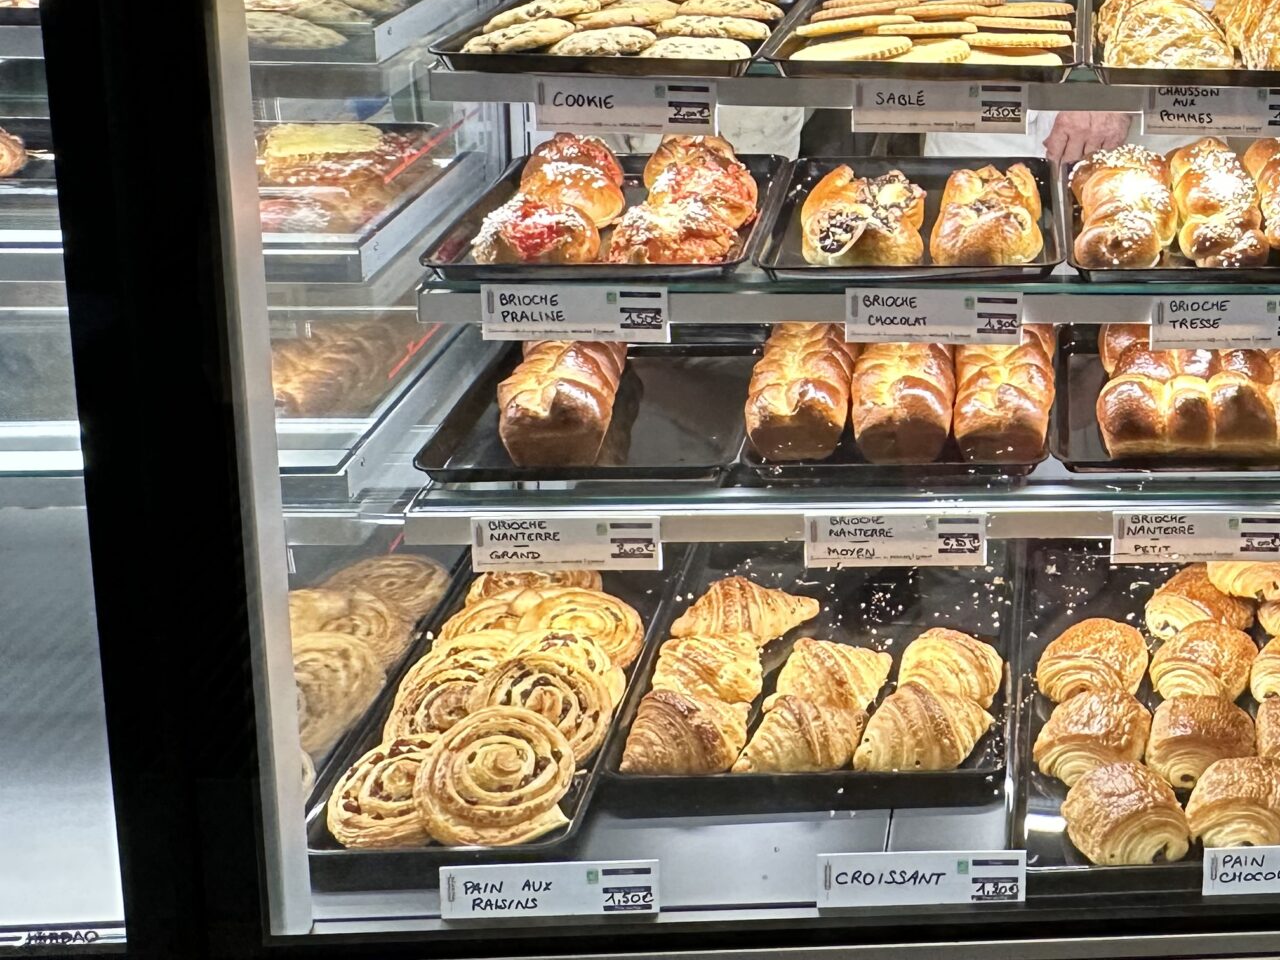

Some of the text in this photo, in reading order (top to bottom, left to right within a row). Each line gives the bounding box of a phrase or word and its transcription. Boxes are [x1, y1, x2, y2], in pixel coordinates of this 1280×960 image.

[1158, 87, 1220, 97] CHAUSSON
[552, 91, 615, 109] COOKIE
[875, 91, 926, 107] SABLÉ
[1173, 98, 1196, 107] AUX
[1160, 109, 1214, 124] POMMES
[499, 293, 559, 307] BRIOCHE
[862, 294, 918, 309] BRIOCHE
[1169, 300, 1231, 313] BRIOCHE
[501, 310, 566, 323] PRALINE
[867, 314, 928, 326] CHOCOLAT
[1168, 317, 1222, 330] TRESSE
[488, 520, 547, 530] BRIOCHE
[1131, 515, 1187, 524] BRIOCHE
[489, 531, 561, 542] NANTERRE
[828, 528, 895, 538] NANTERRE
[1126, 525, 1196, 536] NANTERRE
[827, 547, 876, 557] MOYEN
[1134, 544, 1171, 553] PETIT
[489, 551, 541, 560] GRAND
[1222, 855, 1265, 868] PAIN
[835, 870, 946, 885] CROISSANT
[463, 879, 553, 895] PAIN AUX
[472, 898, 538, 911] RAISINS
